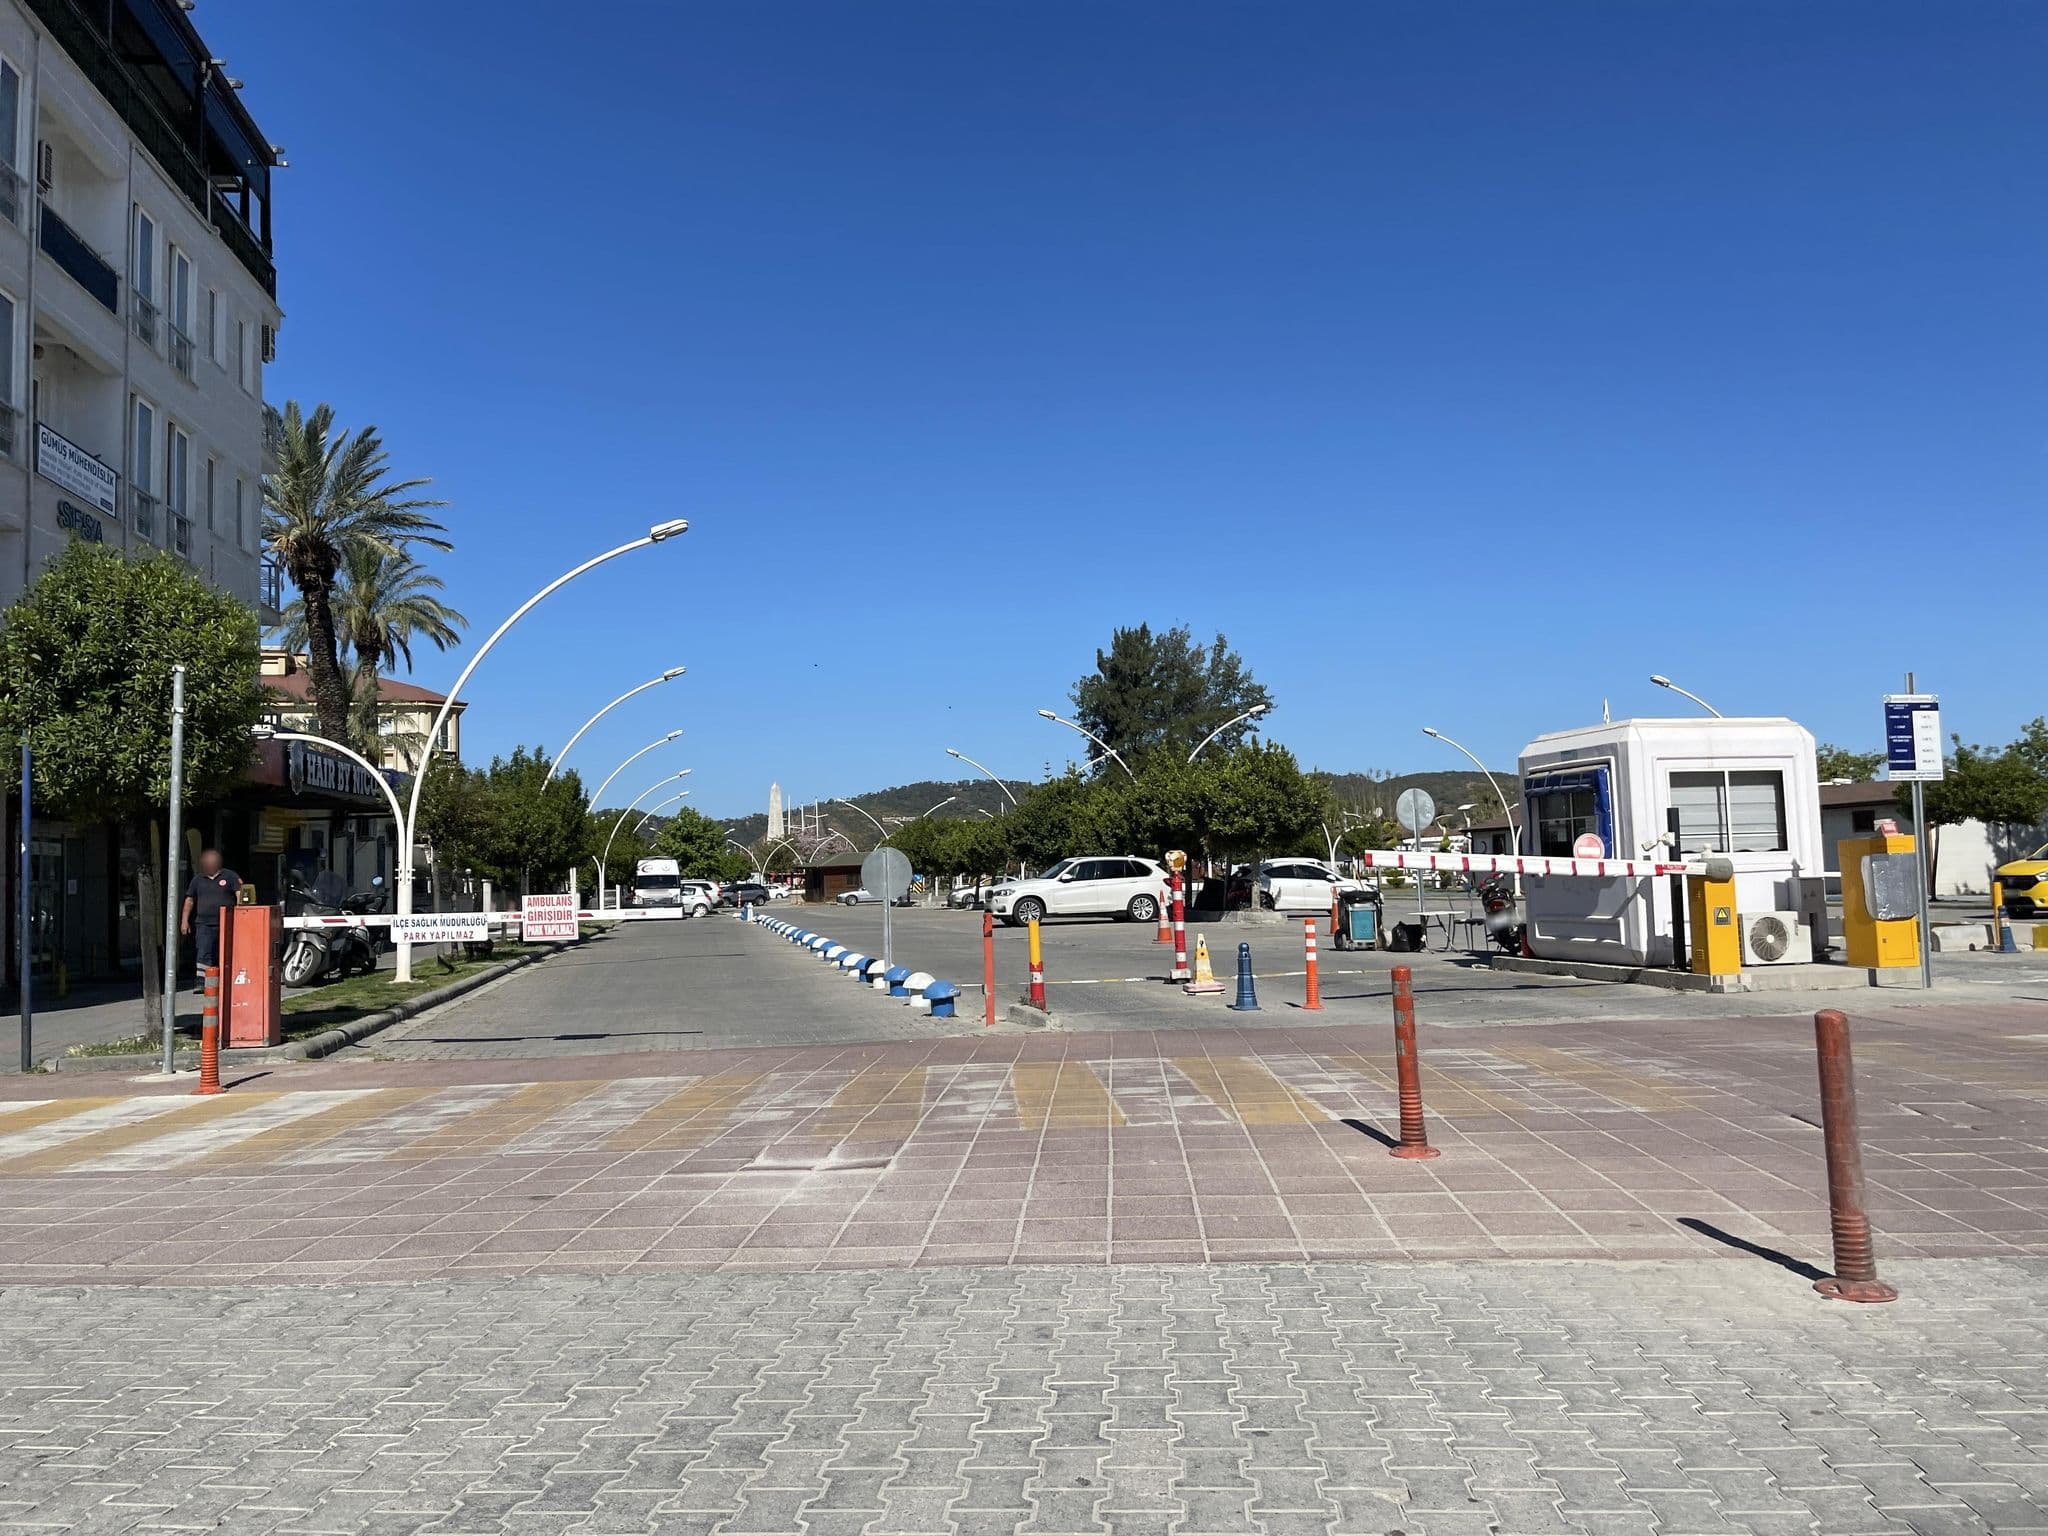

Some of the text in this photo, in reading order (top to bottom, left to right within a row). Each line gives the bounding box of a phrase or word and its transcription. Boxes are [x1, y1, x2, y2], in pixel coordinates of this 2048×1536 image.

[41, 431, 67, 460] GÜMÜŞ
[69, 449, 114, 486] MÜHENDİSLİK
[307, 753, 335, 789] HAIR
[337, 762, 350, 792] BY
[527, 895, 573, 922] AMBULANS GİRİŞİDİR
[393, 917, 409, 929] İLÇE
[410, 917, 438, 928] SAĞLIK
[439, 916, 487, 928] MÜDÜRLÜĞÜ
[404, 930, 475, 941] PARK YAPILMAZ
